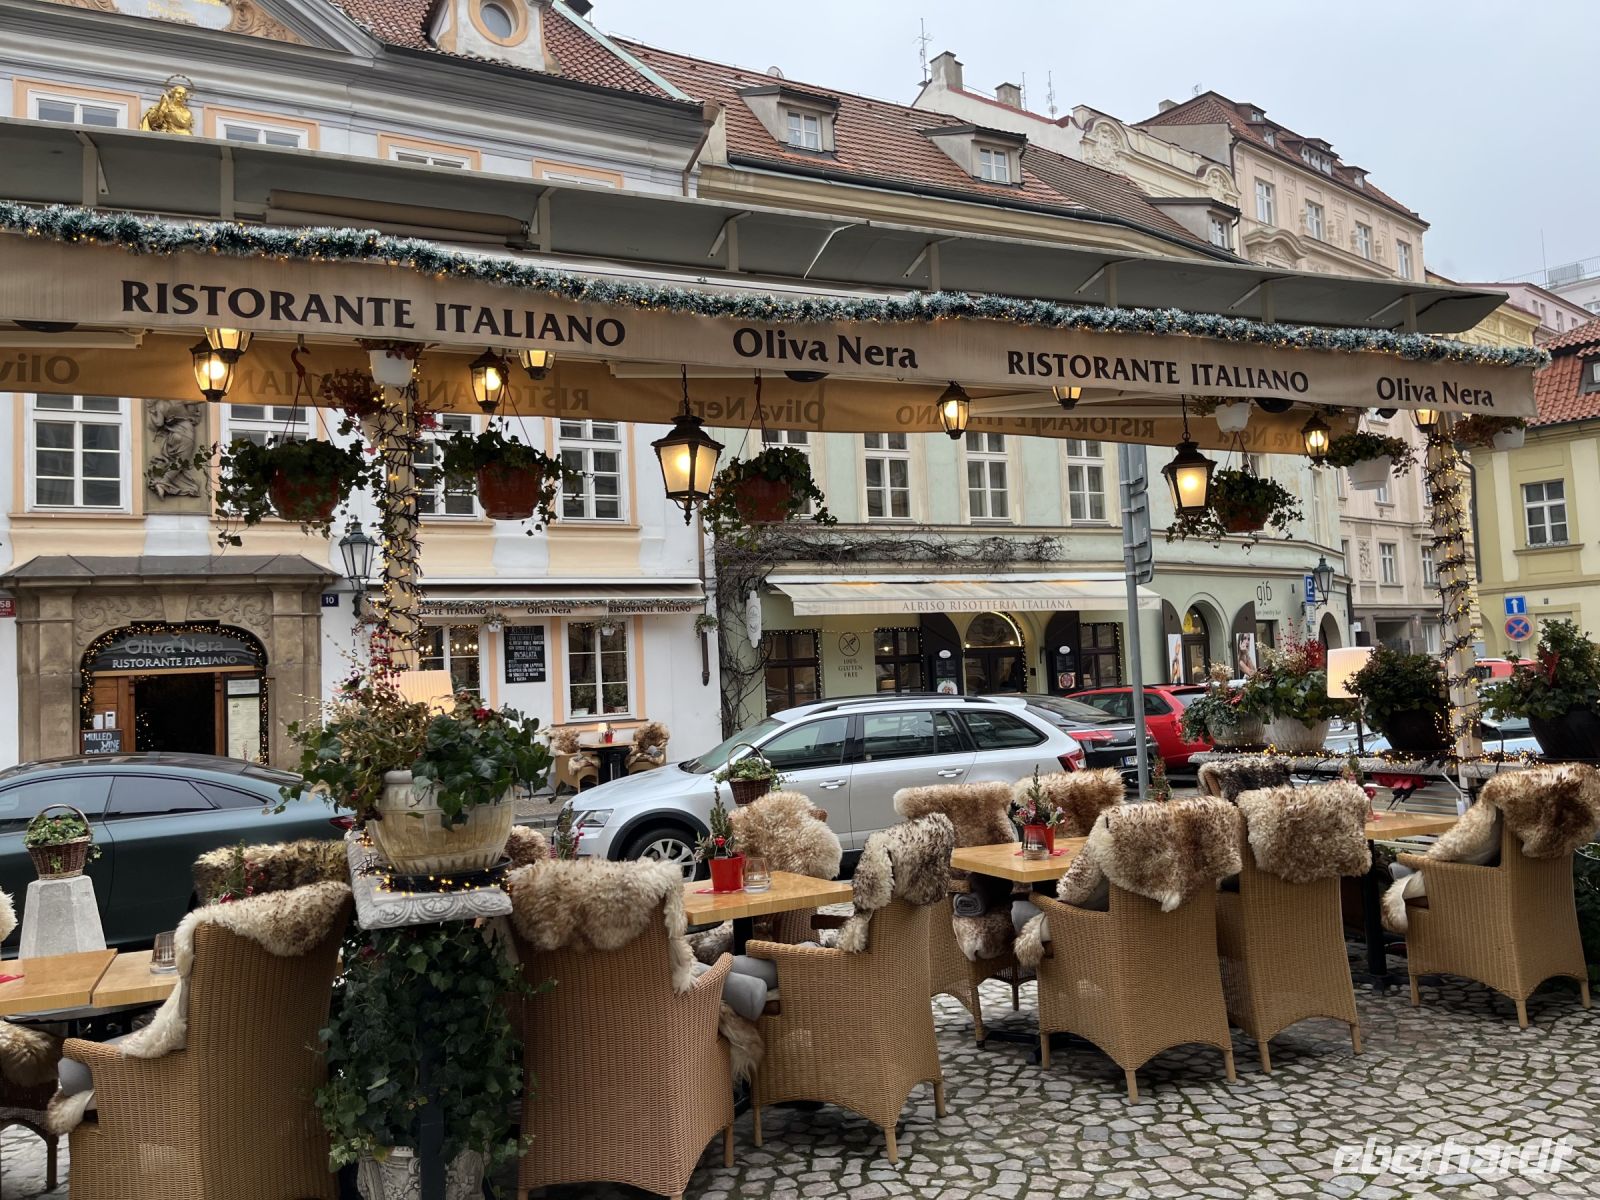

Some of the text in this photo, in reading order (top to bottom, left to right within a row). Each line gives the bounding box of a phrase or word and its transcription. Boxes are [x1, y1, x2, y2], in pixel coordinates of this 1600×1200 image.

[122, 280, 626, 347] RISTORANTE ITALIANO
[733, 327, 919, 369] Oliva Nera
[1007, 349, 1309, 393] RISTORANTE ITALIANO
[1376, 375, 1494, 407] Oliva Nera
[325, 596, 335, 604] 10
[902, 600, 1073, 611] ALRISO RISOTTERIA ITALIANA
[446, 607, 487, 615] ITALIANO
[527, 606, 572, 614] Oliva Nera
[608, 604, 692, 613] RISTORANTE ITALIANO
[125, 638, 224, 654] Oliva Nera
[112, 655, 238, 668] RISTORANTE ITALIANO
[83, 732, 113, 741] MULLED
